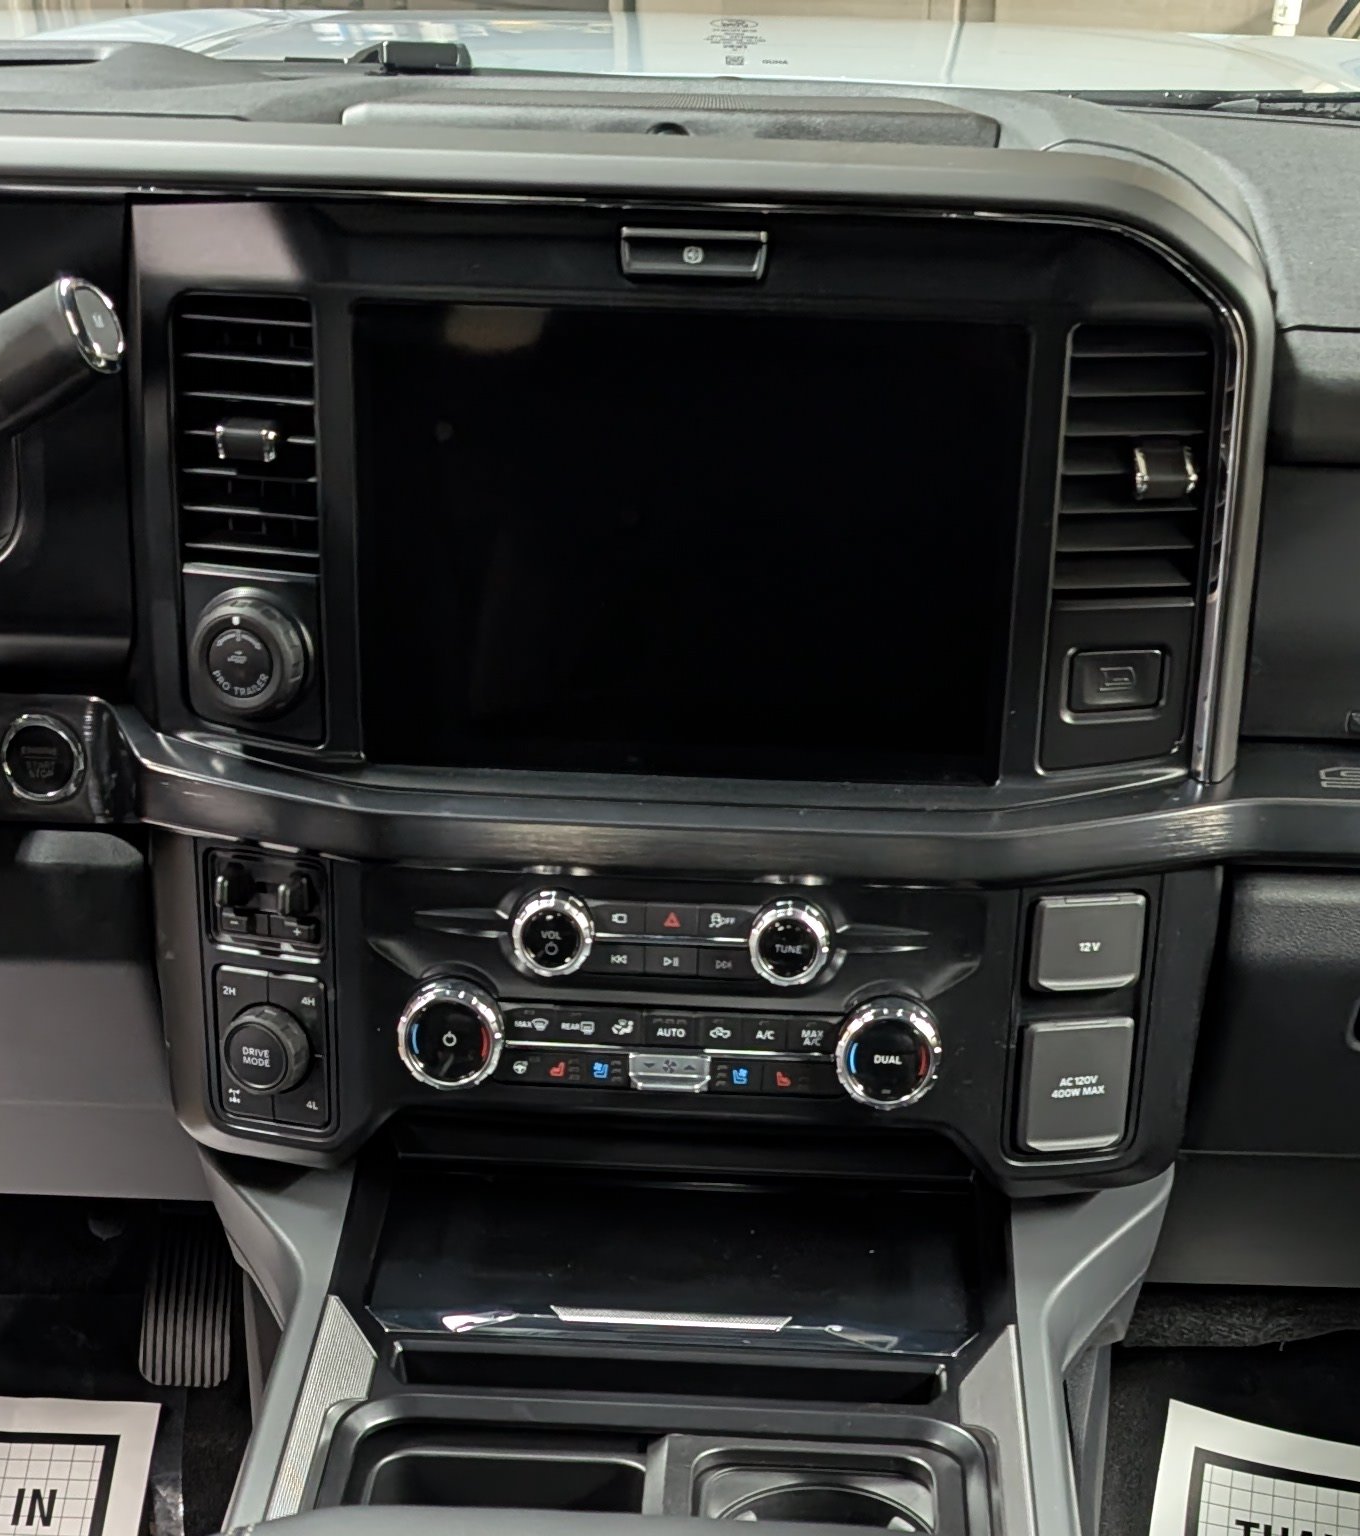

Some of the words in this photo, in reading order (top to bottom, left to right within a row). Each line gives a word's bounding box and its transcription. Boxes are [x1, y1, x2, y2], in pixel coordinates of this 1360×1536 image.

[211, 669, 232, 691] PRO
[233, 672, 270, 697] TRAILER
[540, 930, 562, 941] VOL
[775, 943, 803, 955] TUNE
[222, 985, 237, 997] 2H
[300, 996, 316, 1007] 4H
[656, 1027, 686, 1038] AUTO
[755, 1030, 775, 1040] A/C
[800, 1029, 824, 1038] MAX
[802, 1037, 822, 1046] A/C
[242, 1046, 270, 1058] DRIVE
[242, 1056, 271, 1067] MODE
[873, 1054, 903, 1065] DUAL
[1059, 1076, 1074, 1087] AC
[1073, 1074, 1099, 1086] 120V
[1051, 1087, 1081, 1099] 400W
[1081, 1084, 1106, 1096] MAX
[306, 1100, 319, 1110] 4L
[10, 1487, 59, 1528] IN
